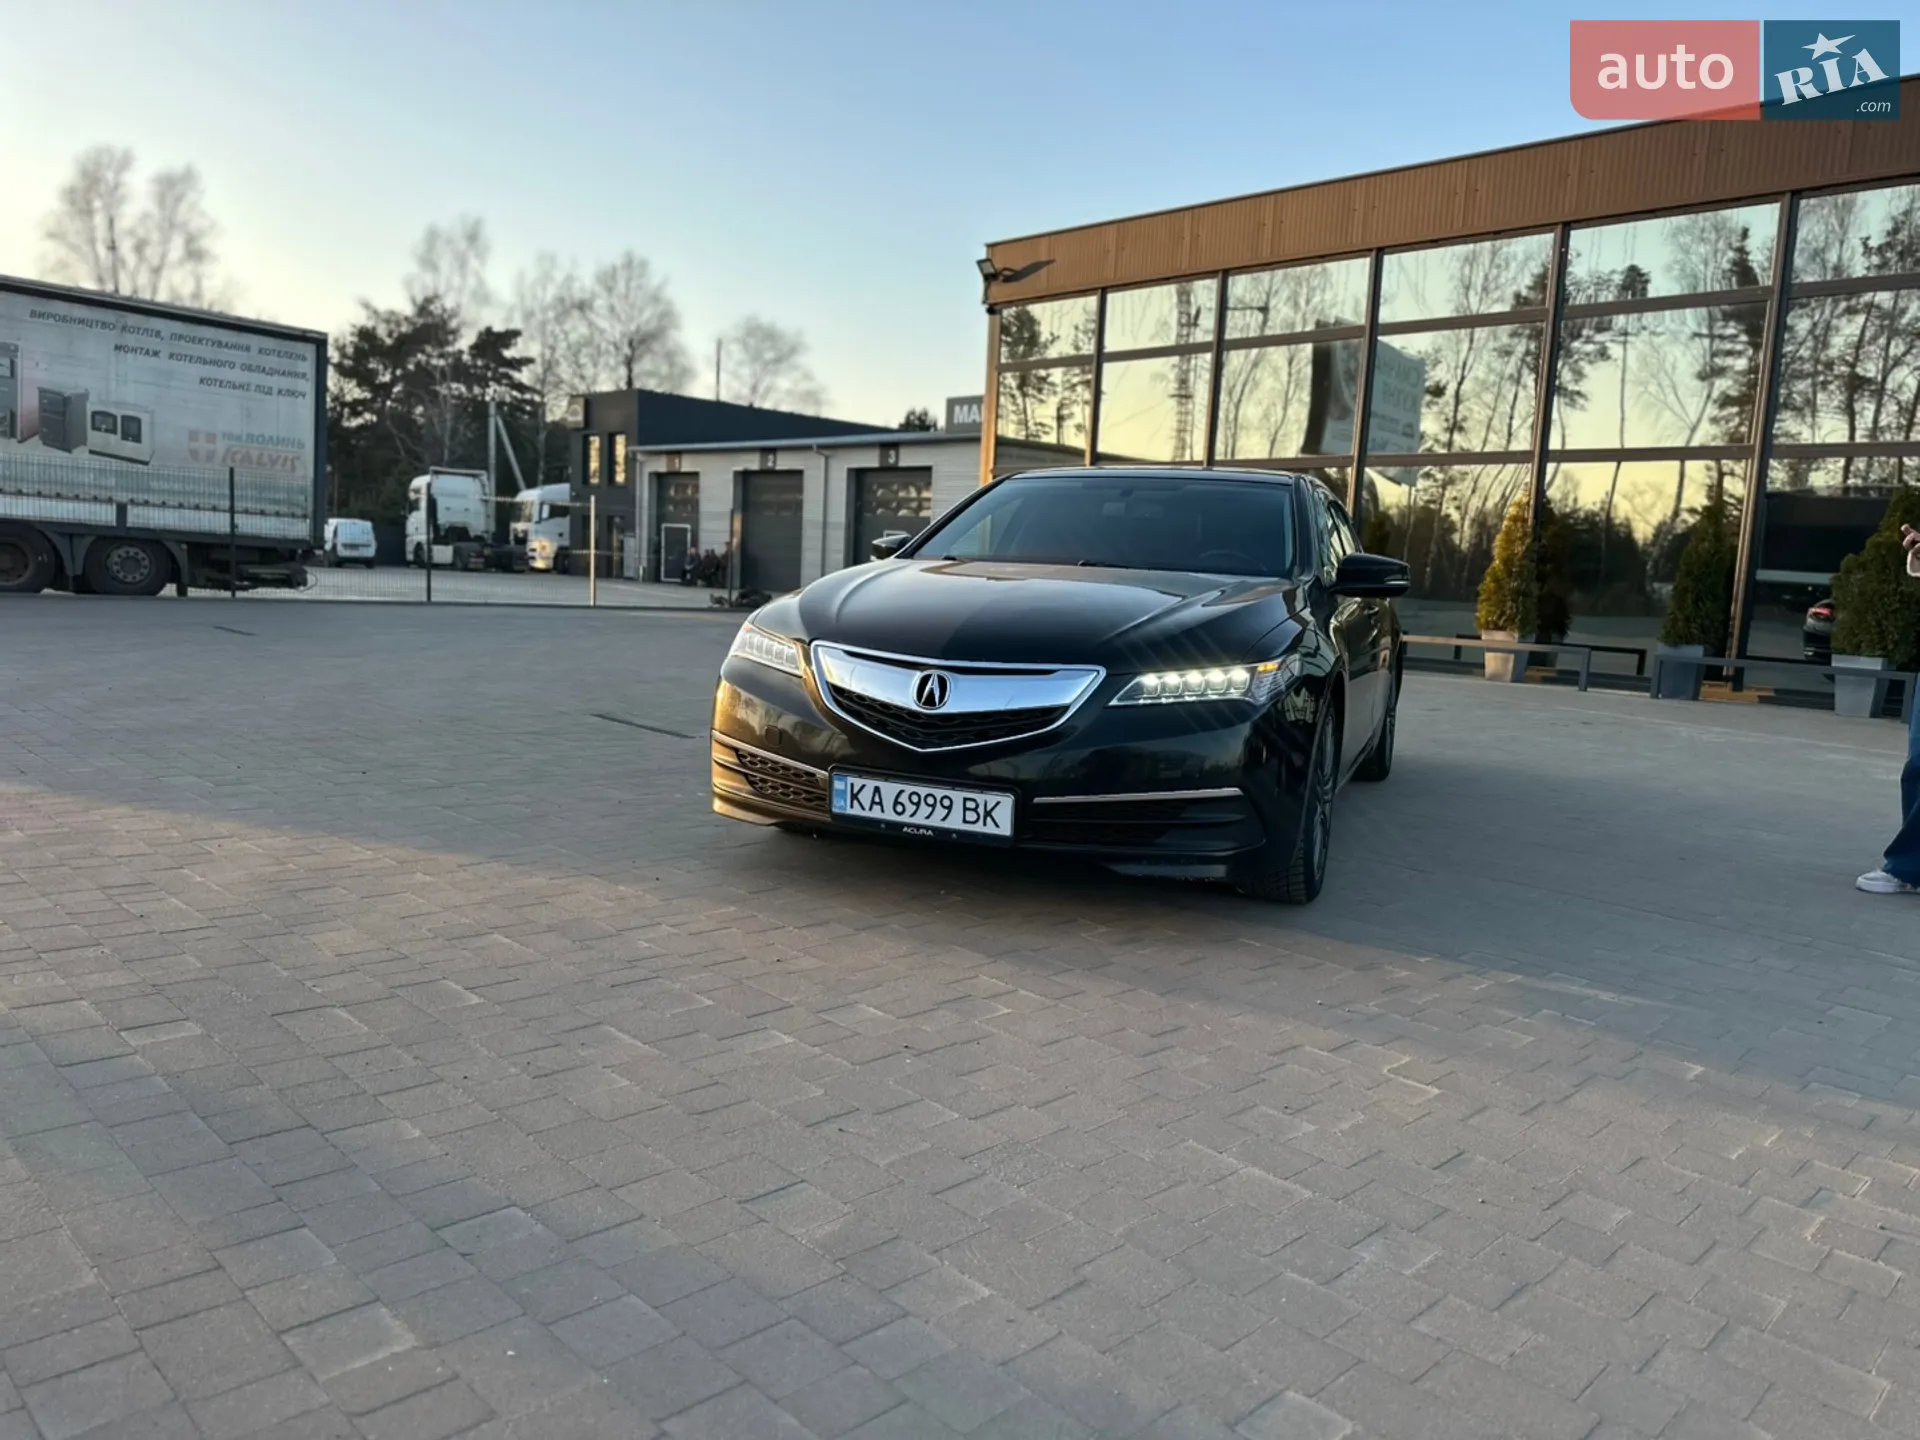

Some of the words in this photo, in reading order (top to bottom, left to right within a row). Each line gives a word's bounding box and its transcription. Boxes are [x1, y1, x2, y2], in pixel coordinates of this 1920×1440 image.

[29, 309, 116, 331] ВИРОБНИЦТВО
[120, 323, 164, 341] КОТЛІВ,
[169, 331, 252, 353] ПРОЕКТУВАННЯ
[113, 343, 162, 358] МОНТАЖ
[168, 352, 236, 370] КОТЕЛЬНОГО
[240, 363, 310, 382] ОБЛАДНАННЯ,
[199, 375, 251, 392] КОТЕЛЬНІ
[254, 384, 273, 397] ПІД
[276, 388, 307, 401] КЛЮЧ
[767, 454, 775, 467] 2
[888, 450, 896, 464] 3
[849, 782, 885, 814] KA
[892, 789, 953, 822] 6999
[962, 797, 1001, 828] BK
[902, 825, 934, 837] ACURA
